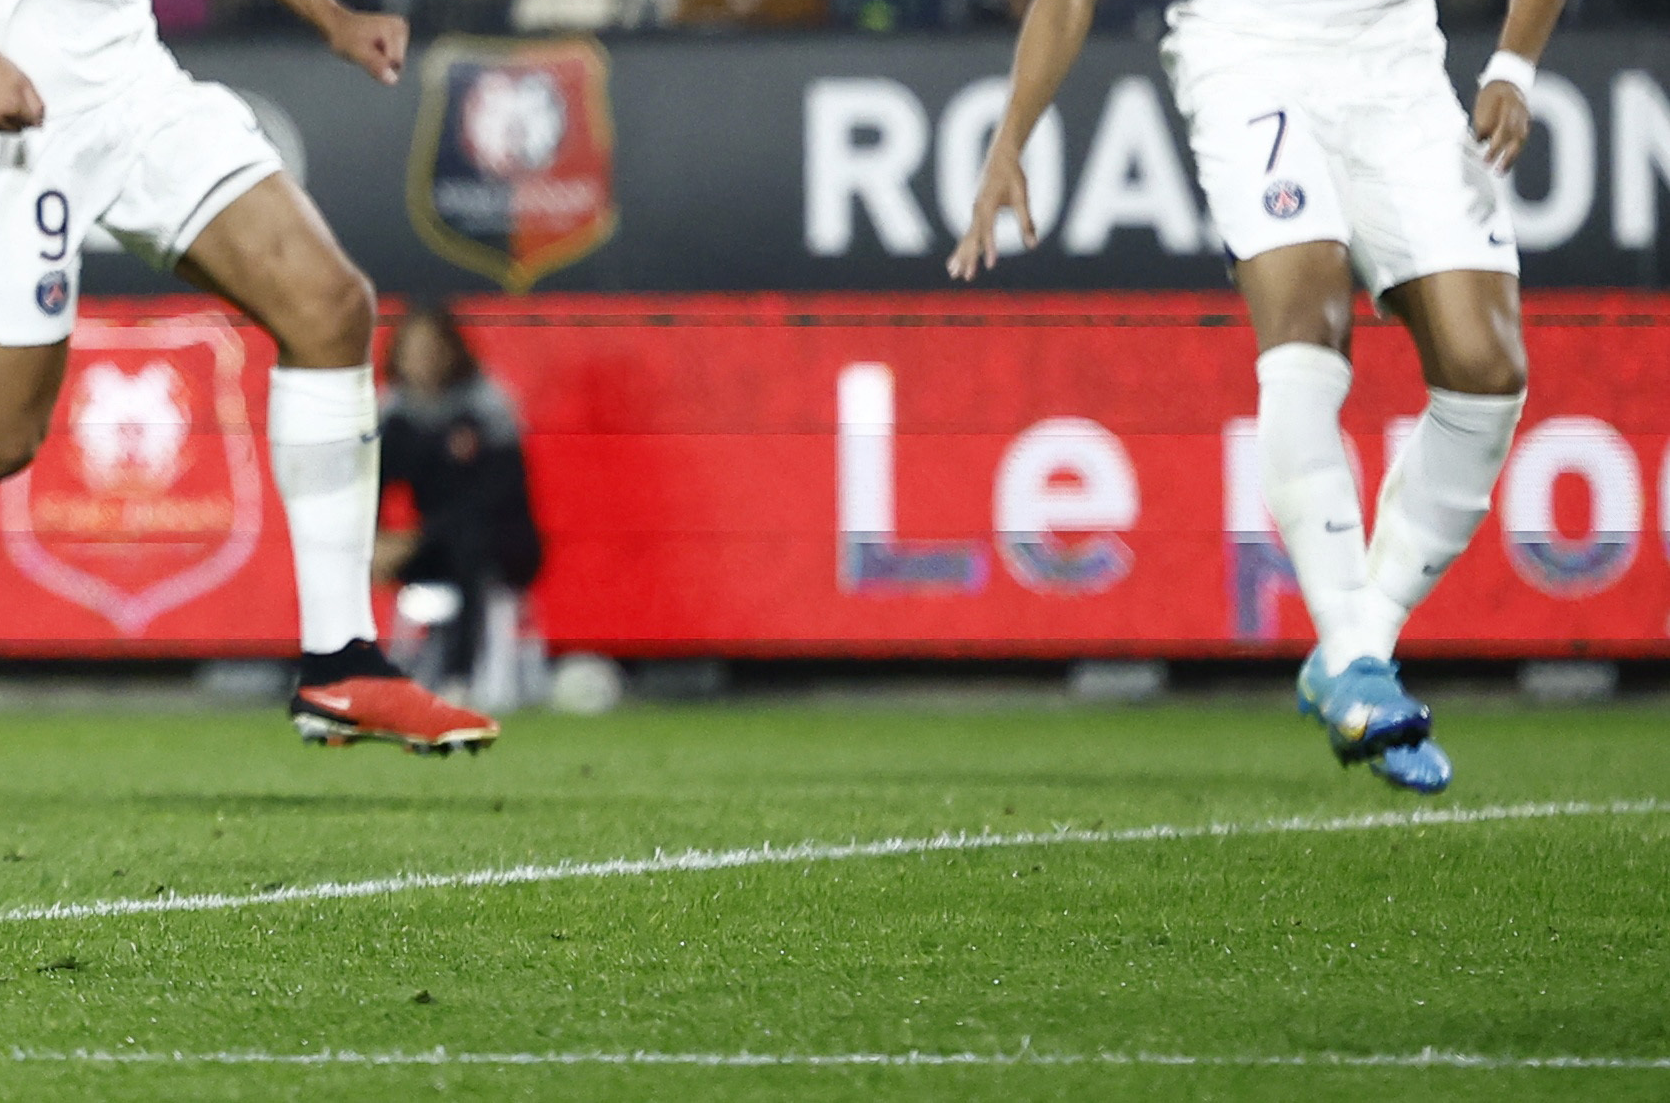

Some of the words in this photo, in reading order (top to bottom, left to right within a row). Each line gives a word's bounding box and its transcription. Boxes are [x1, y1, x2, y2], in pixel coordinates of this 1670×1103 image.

[1247, 109, 1289, 176] 7
[35, 190, 70, 261] 9
[835, 361, 1141, 597] Le
